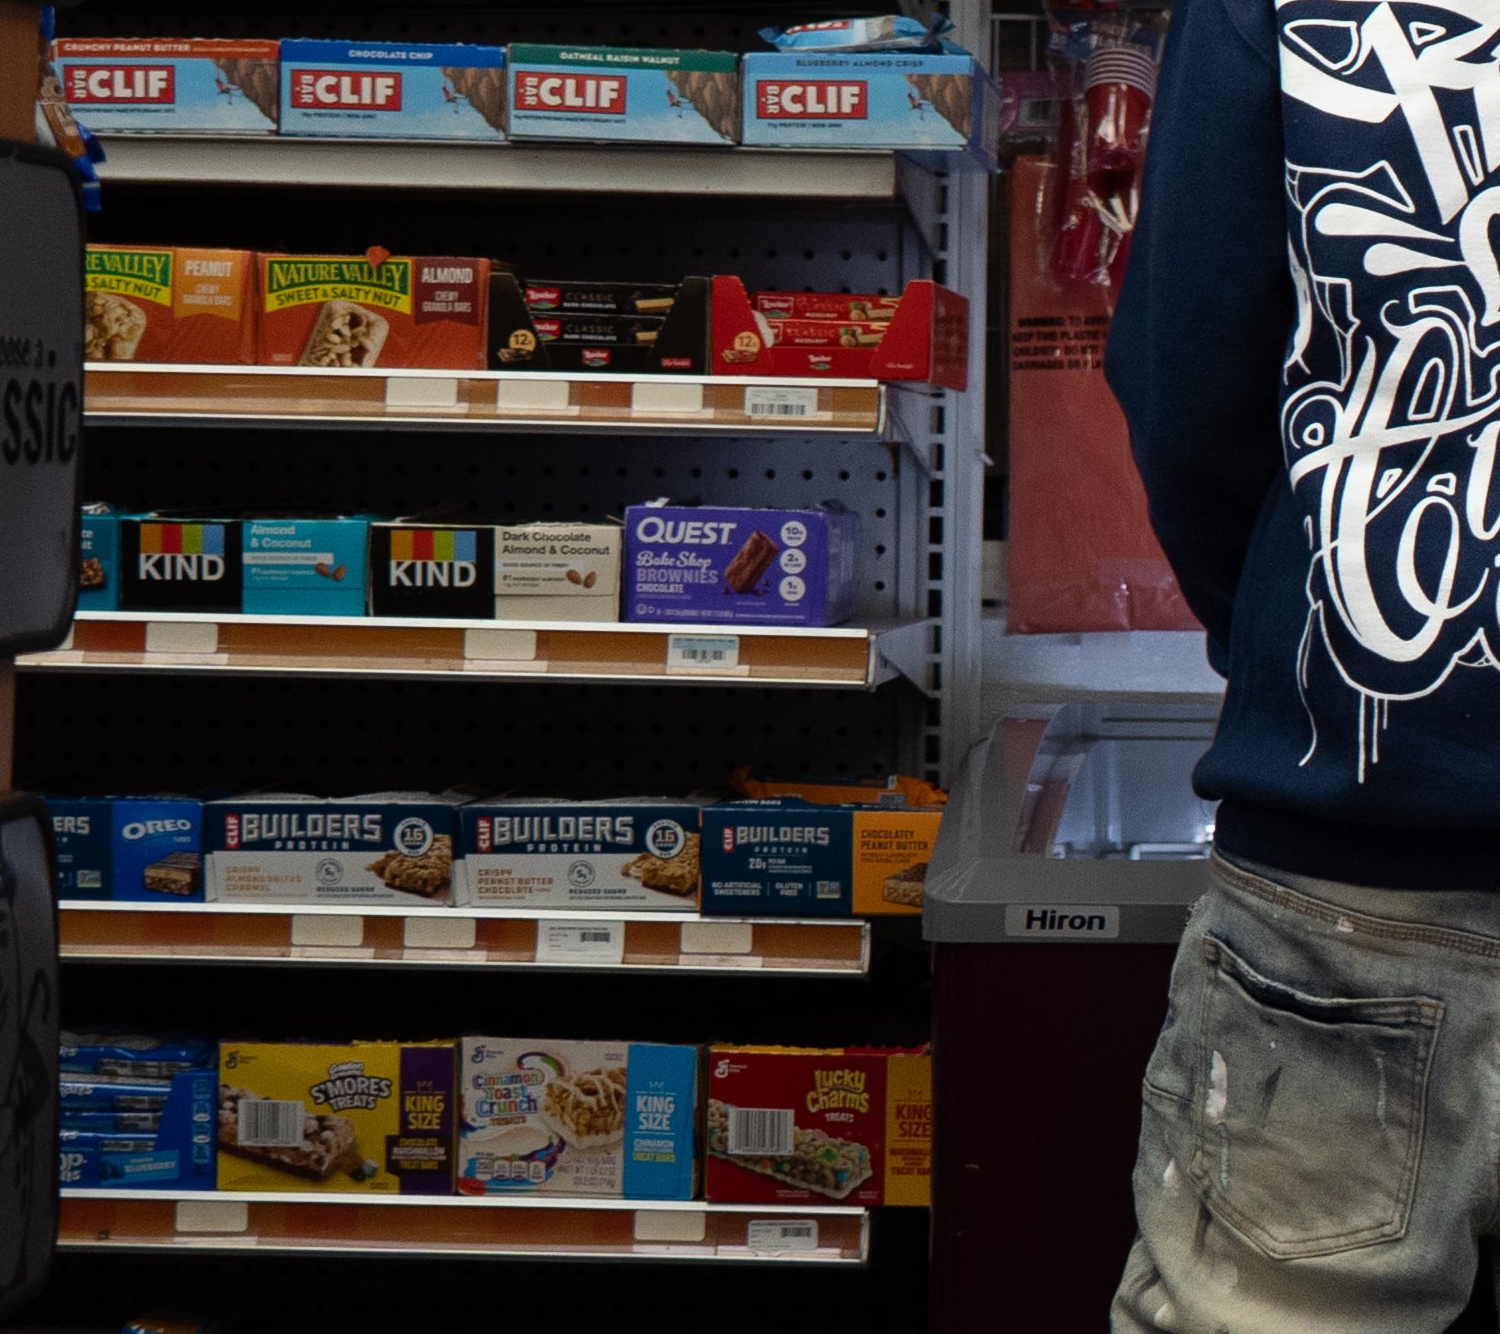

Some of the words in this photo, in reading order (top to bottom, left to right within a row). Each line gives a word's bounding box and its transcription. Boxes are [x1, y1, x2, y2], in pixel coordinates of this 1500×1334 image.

[113, 44, 153, 53] PEANUT
[155, 44, 190, 53] BUTTER
[349, 50, 405, 60] CHOCOLATE
[408, 51, 433, 60] CHIP
[560, 52, 605, 62] OATMEAL
[606, 53, 640, 63] RAISIN
[643, 55, 681, 65] WALNUT
[87, 70, 169, 98] CLIF
[314, 76, 396, 104] CLIF
[539, 79, 621, 108] CLIF
[780, 86, 861, 114] CLIF
[104, 254, 167, 282] VALLEY
[184, 259, 233, 278] PEANUT
[272, 264, 340, 287] NATURE
[339, 263, 407, 292] VALLEY
[421, 268, 473, 284] ALMOND
[133, 283, 162, 299] NUT
[276, 287, 322, 307] SWEET
[331, 287, 369, 303] SALTY
[371, 291, 401, 307] NUT
[502, 531, 530, 542] Dark
[532, 531, 592, 543] Chocolate
[636, 517, 737, 546] QUEST
[502, 545, 547, 556] Almond
[560, 545, 610, 556] Coconut
[138, 553, 225, 582] KIND
[389, 560, 477, 588] KIND
[636, 568, 719, 584] BROWNIES
[636, 583, 684, 594] CHOCOLATE
[122, 818, 192, 841] OREO
[242, 813, 382, 843] BUILDERS
[494, 815, 634, 847] BUILDERS
[736, 826, 830, 847] BUILDERS
[1026, 909, 1106, 931] Hiron
[813, 1069, 867, 1093] Lucky
[405, 1095, 445, 1114] KING
[636, 1095, 675, 1115] KING
[805, 1089, 870, 1113] Charms
[408, 1113, 441, 1130] SIZE
[638, 1113, 671, 1131] SIZE
